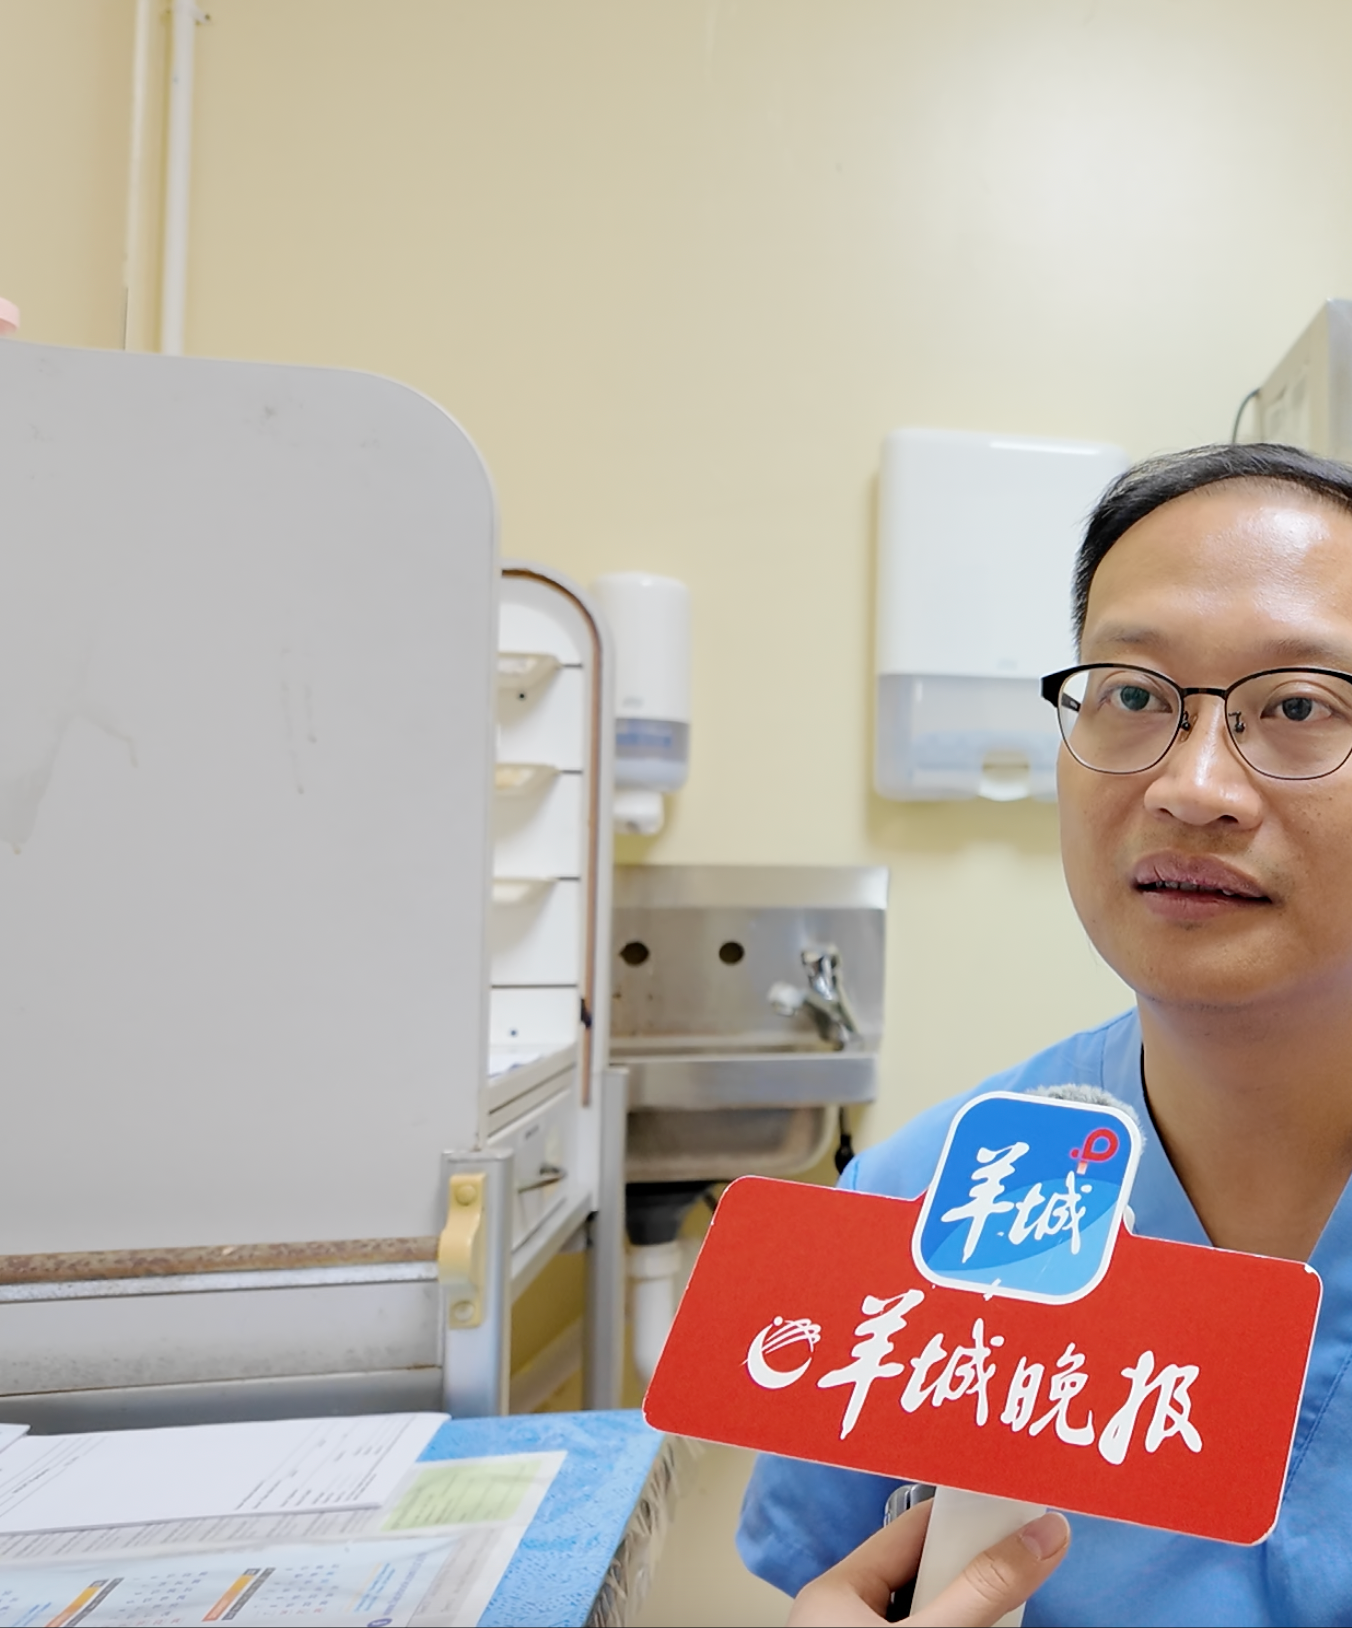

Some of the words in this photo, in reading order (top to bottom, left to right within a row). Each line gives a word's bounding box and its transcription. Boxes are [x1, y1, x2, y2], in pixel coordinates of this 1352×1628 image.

[942, 1142, 1092, 1263] 羊城
[818, 1289, 1202, 1465] 羊城晚报
